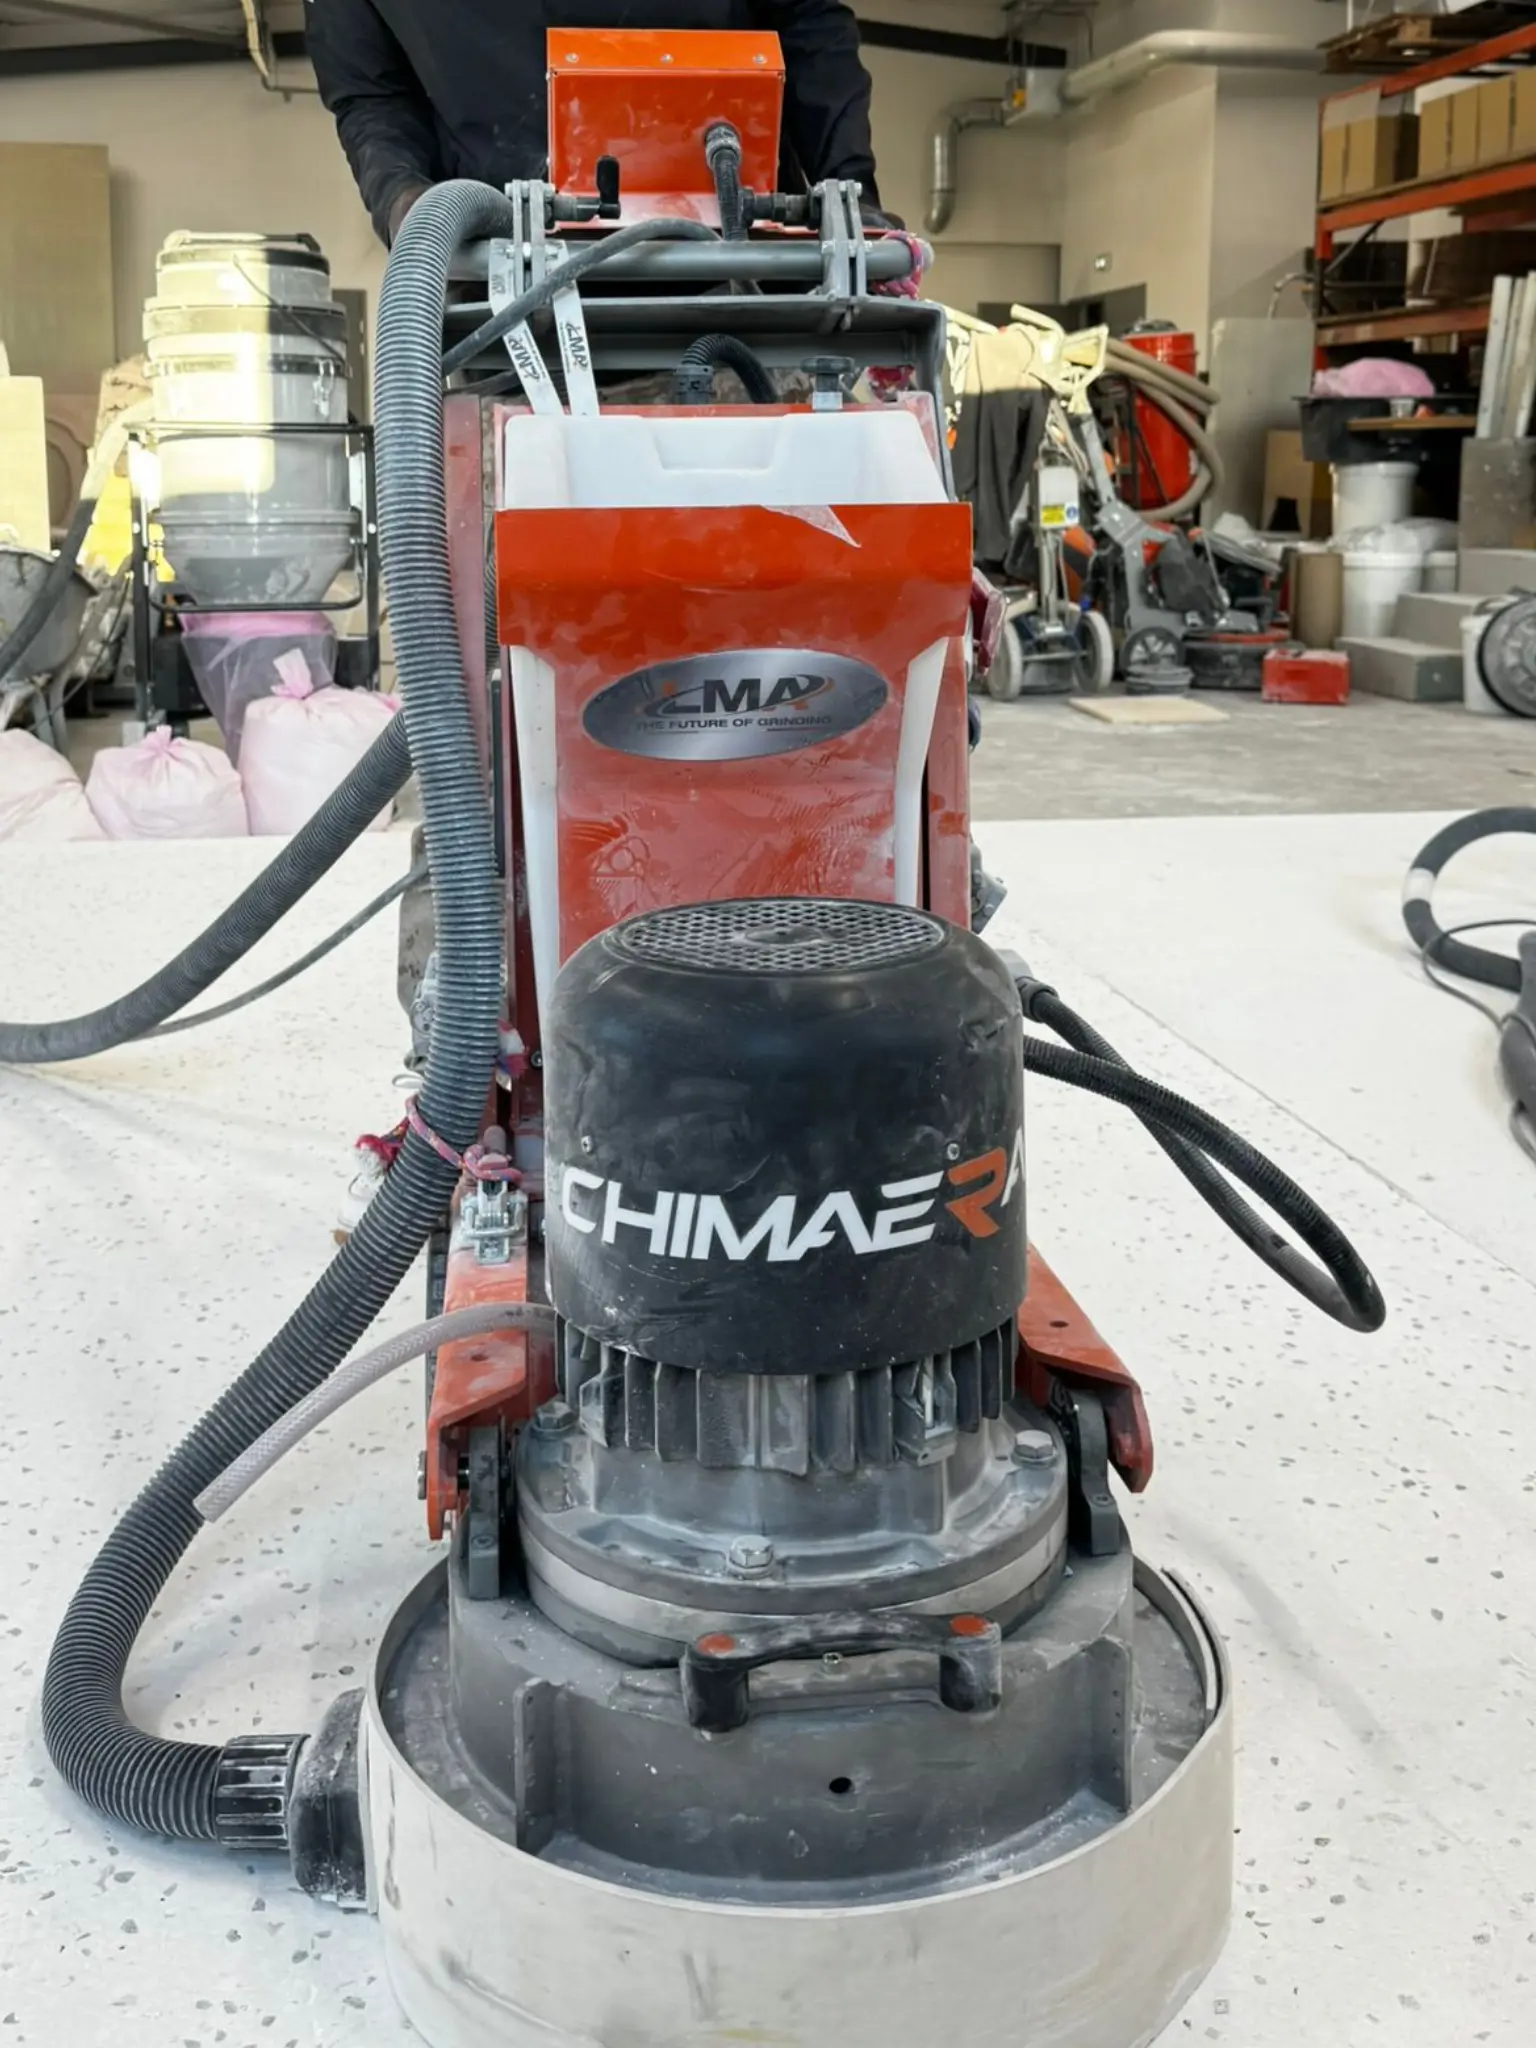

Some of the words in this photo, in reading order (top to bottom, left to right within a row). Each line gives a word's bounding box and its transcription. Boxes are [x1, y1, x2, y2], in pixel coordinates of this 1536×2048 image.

[645, 675, 830, 716] LMA
[637, 721, 664, 731] THE
[669, 719, 729, 730] FUTURE
[733, 718, 753, 728] OF
[758, 716, 832, 727] GRINDING
[562, 1127, 1025, 1262] CHIMAERA
